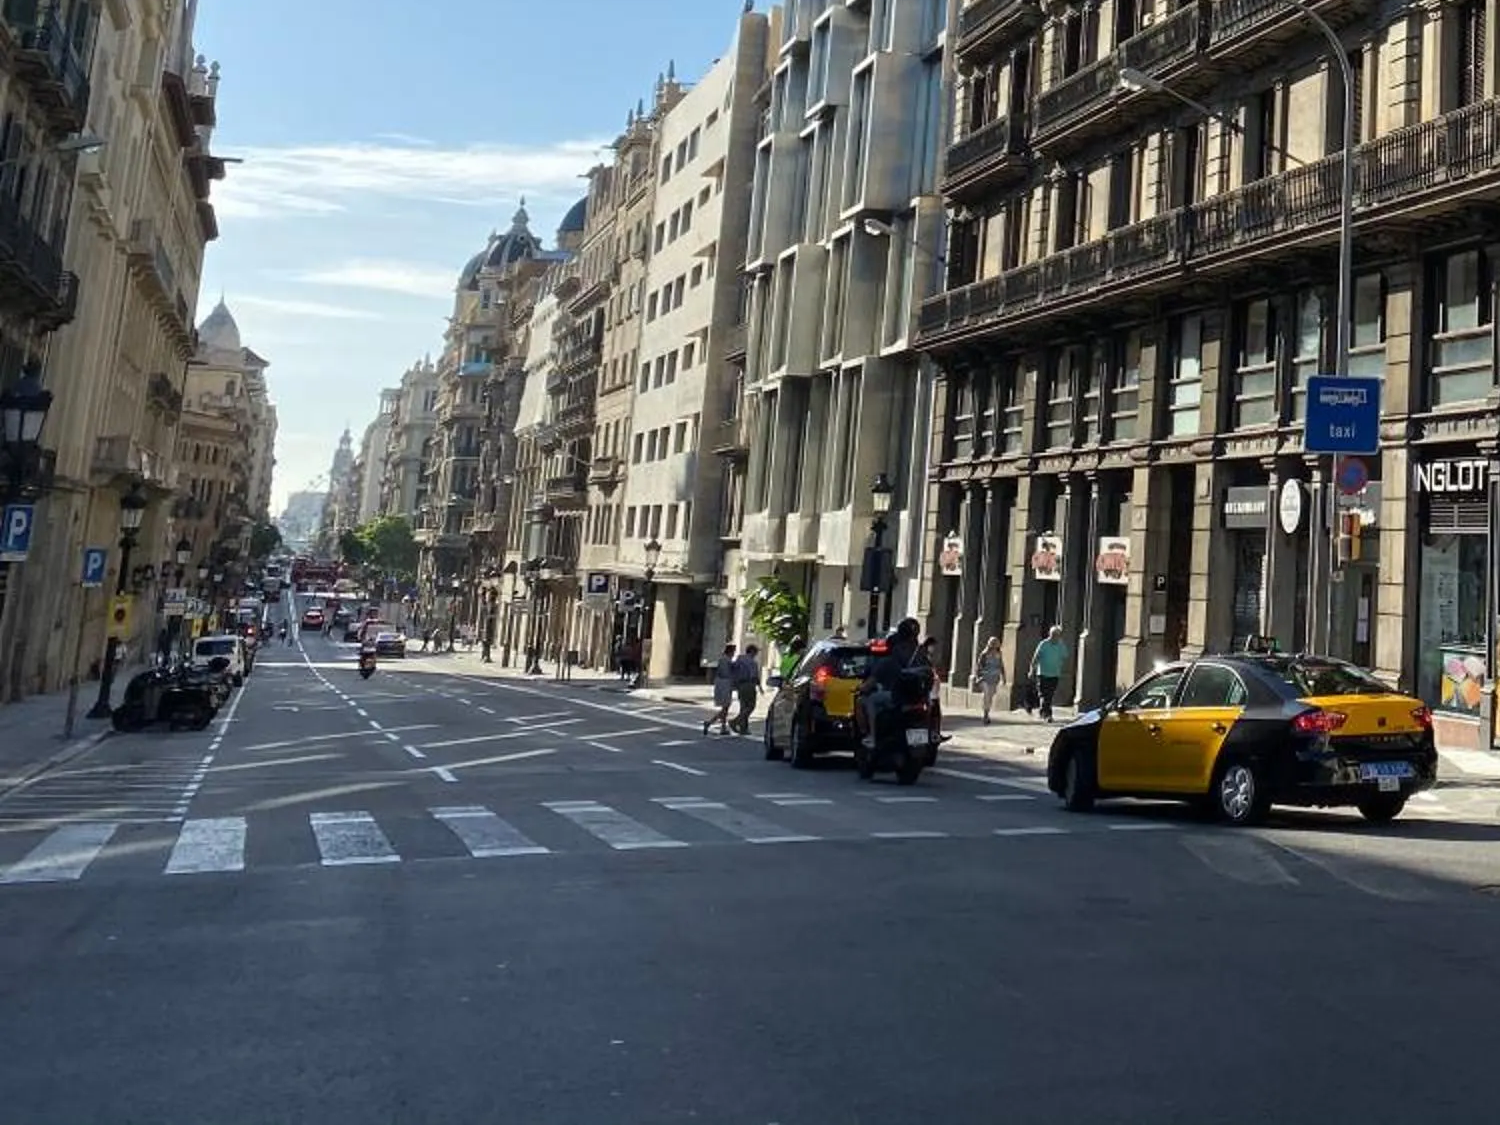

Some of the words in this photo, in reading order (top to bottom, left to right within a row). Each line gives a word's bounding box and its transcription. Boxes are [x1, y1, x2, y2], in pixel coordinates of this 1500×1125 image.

[1329, 423, 1356, 438] taxi
[1414, 461, 1489, 492] INGLOT
[8, 510, 28, 546] P
[87, 552, 102, 577] P
[591, 575, 606, 591] P
